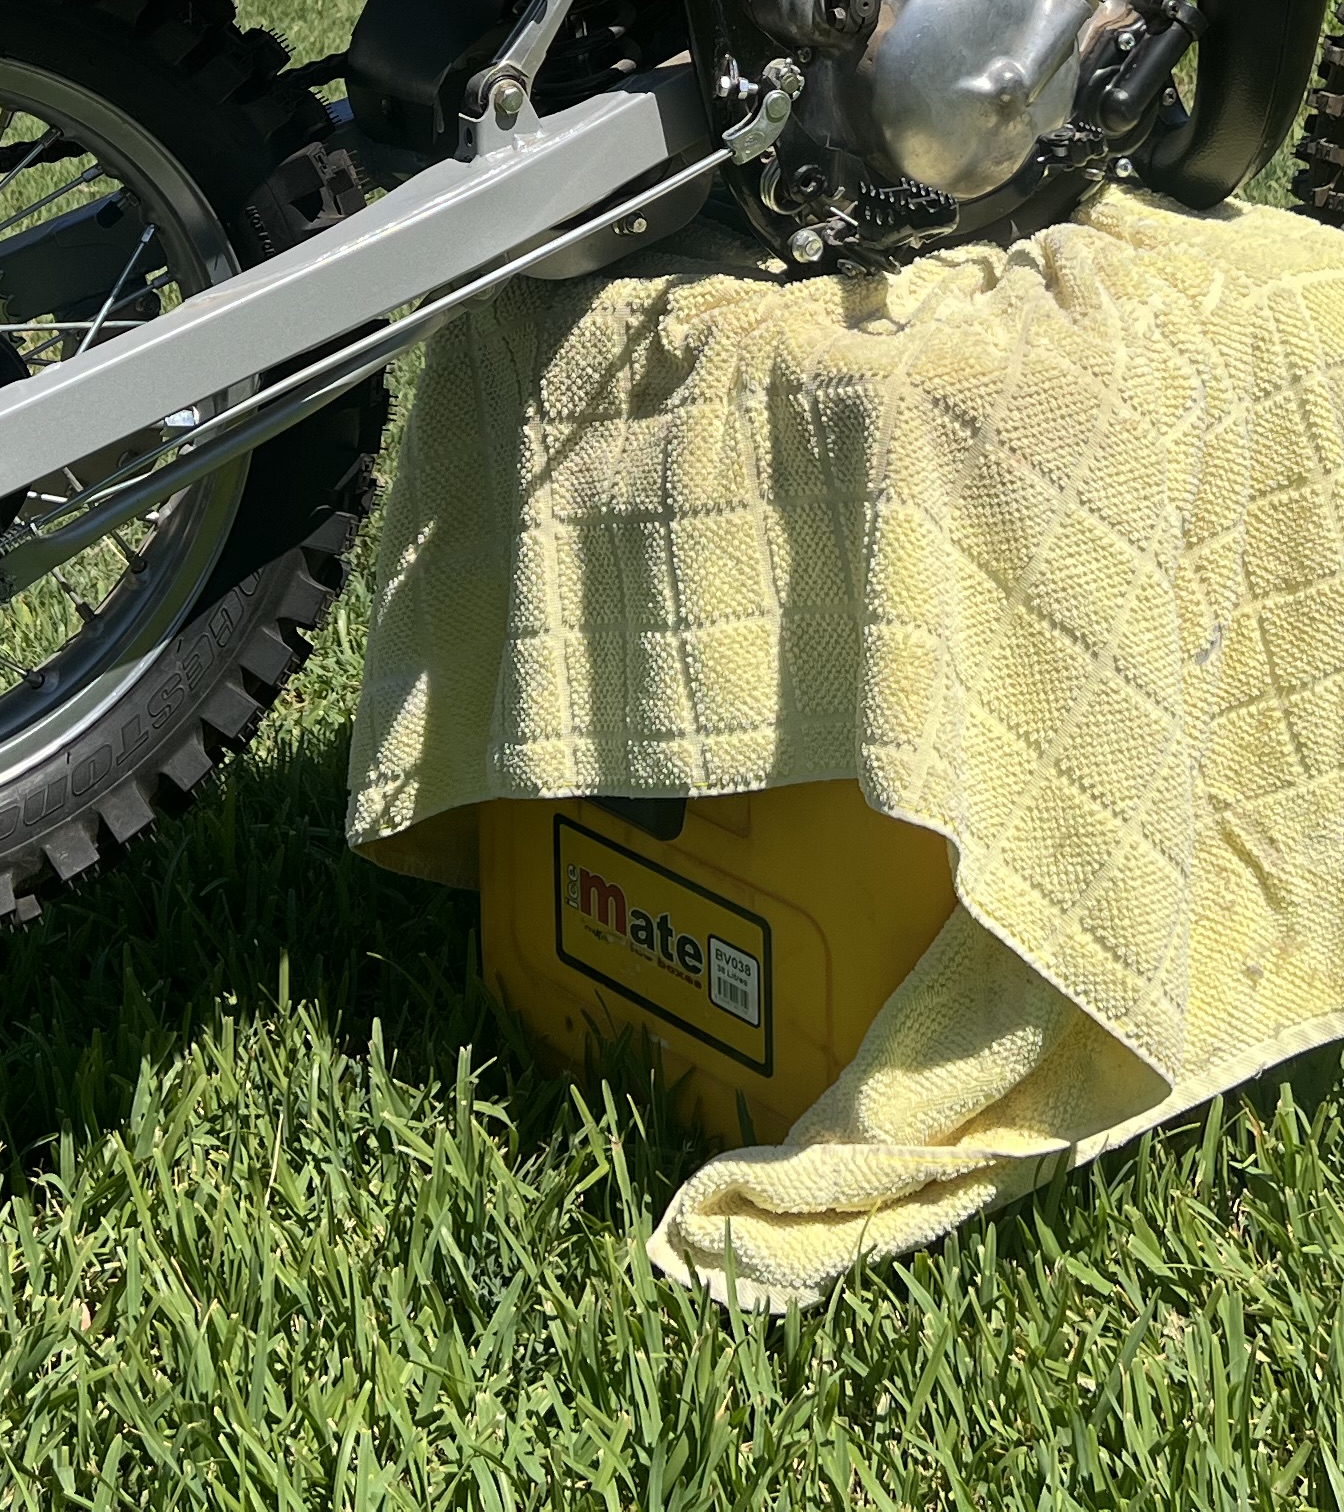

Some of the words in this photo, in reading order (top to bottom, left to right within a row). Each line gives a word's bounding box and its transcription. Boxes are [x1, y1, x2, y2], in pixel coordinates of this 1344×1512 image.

[564, 864, 579, 909] ice
[579, 866, 704, 976] mate
[716, 948, 751, 977] BV038
